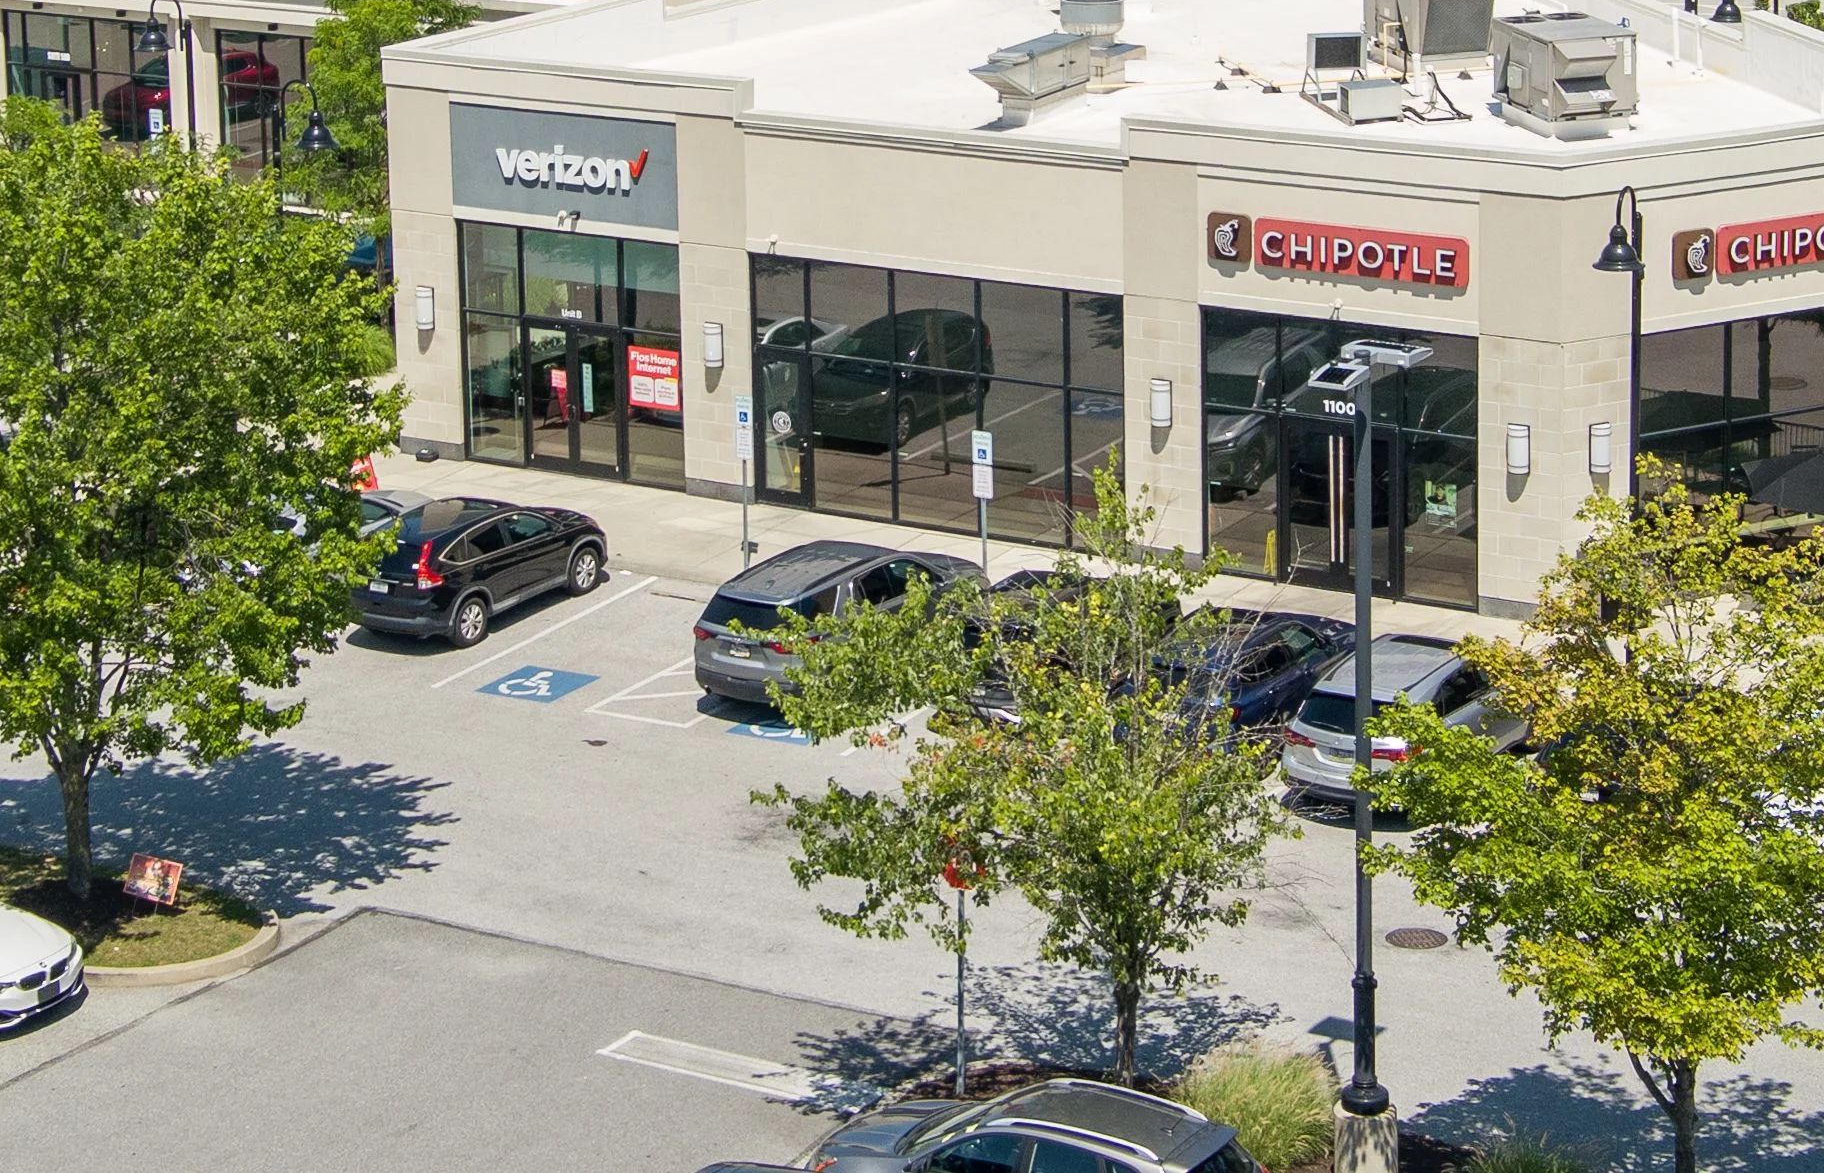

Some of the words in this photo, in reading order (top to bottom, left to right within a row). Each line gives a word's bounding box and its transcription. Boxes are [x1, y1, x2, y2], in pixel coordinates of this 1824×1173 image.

[495, 144, 632, 193] verizon
[1261, 230, 1456, 277] CHIPOTLE
[630, 350, 650, 362] Fios
[649, 353, 678, 367] Home
[636, 361, 673, 376] Internet
[1322, 399, 1356, 416] 1100
